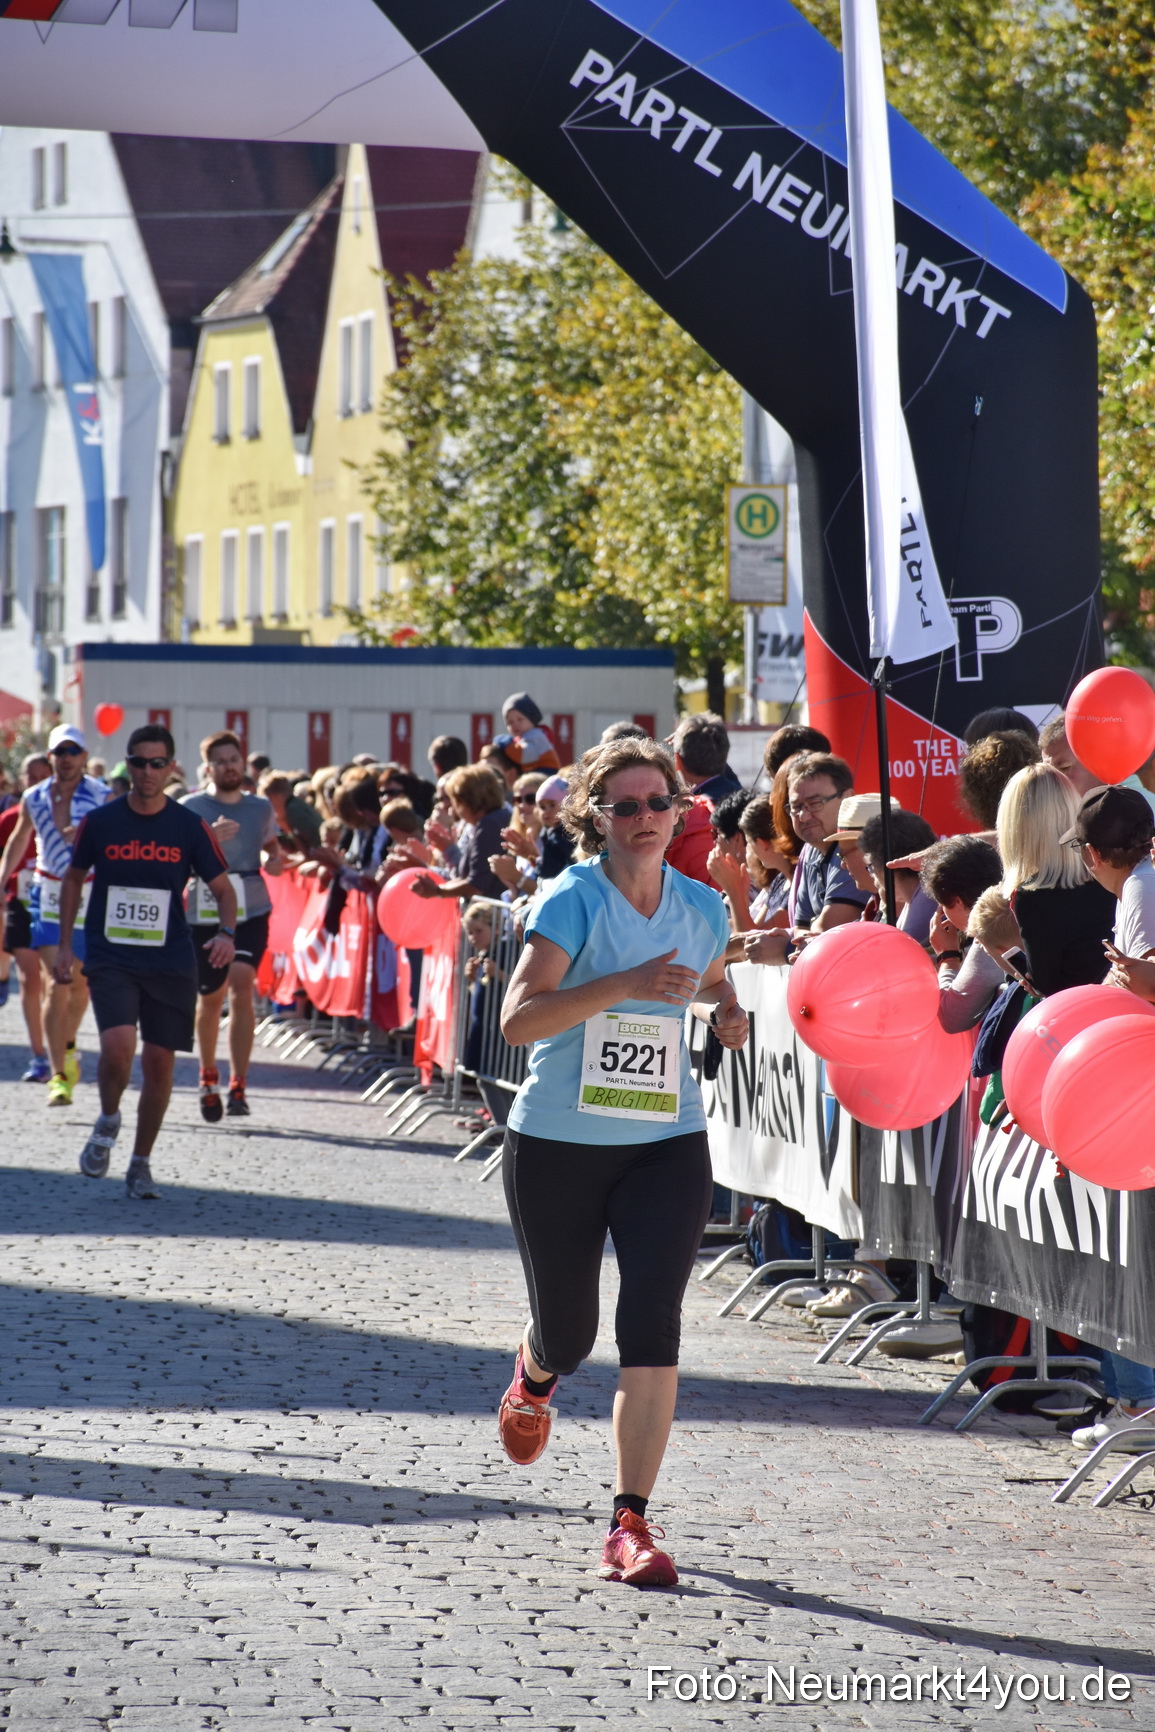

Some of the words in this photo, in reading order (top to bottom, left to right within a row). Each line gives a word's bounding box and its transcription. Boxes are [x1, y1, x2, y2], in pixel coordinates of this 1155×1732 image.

[569, 48, 723, 177] PARTL
[747, 504, 768, 529] H
[950, 605, 968, 614] eam
[969, 603, 991, 613] Partl
[913, 739, 952, 757] THE
[918, 758, 963, 777] YEA
[105, 839, 182, 863] adidas
[116, 902, 160, 922] 5159
[618, 1022, 660, 1036] BOCK
[600, 1041, 667, 1076] 5221
[605, 1076, 628, 1085] PARTL
[629, 1079, 657, 1088] Neumarkt
[588, 1087, 671, 1111] BRIGITTE
